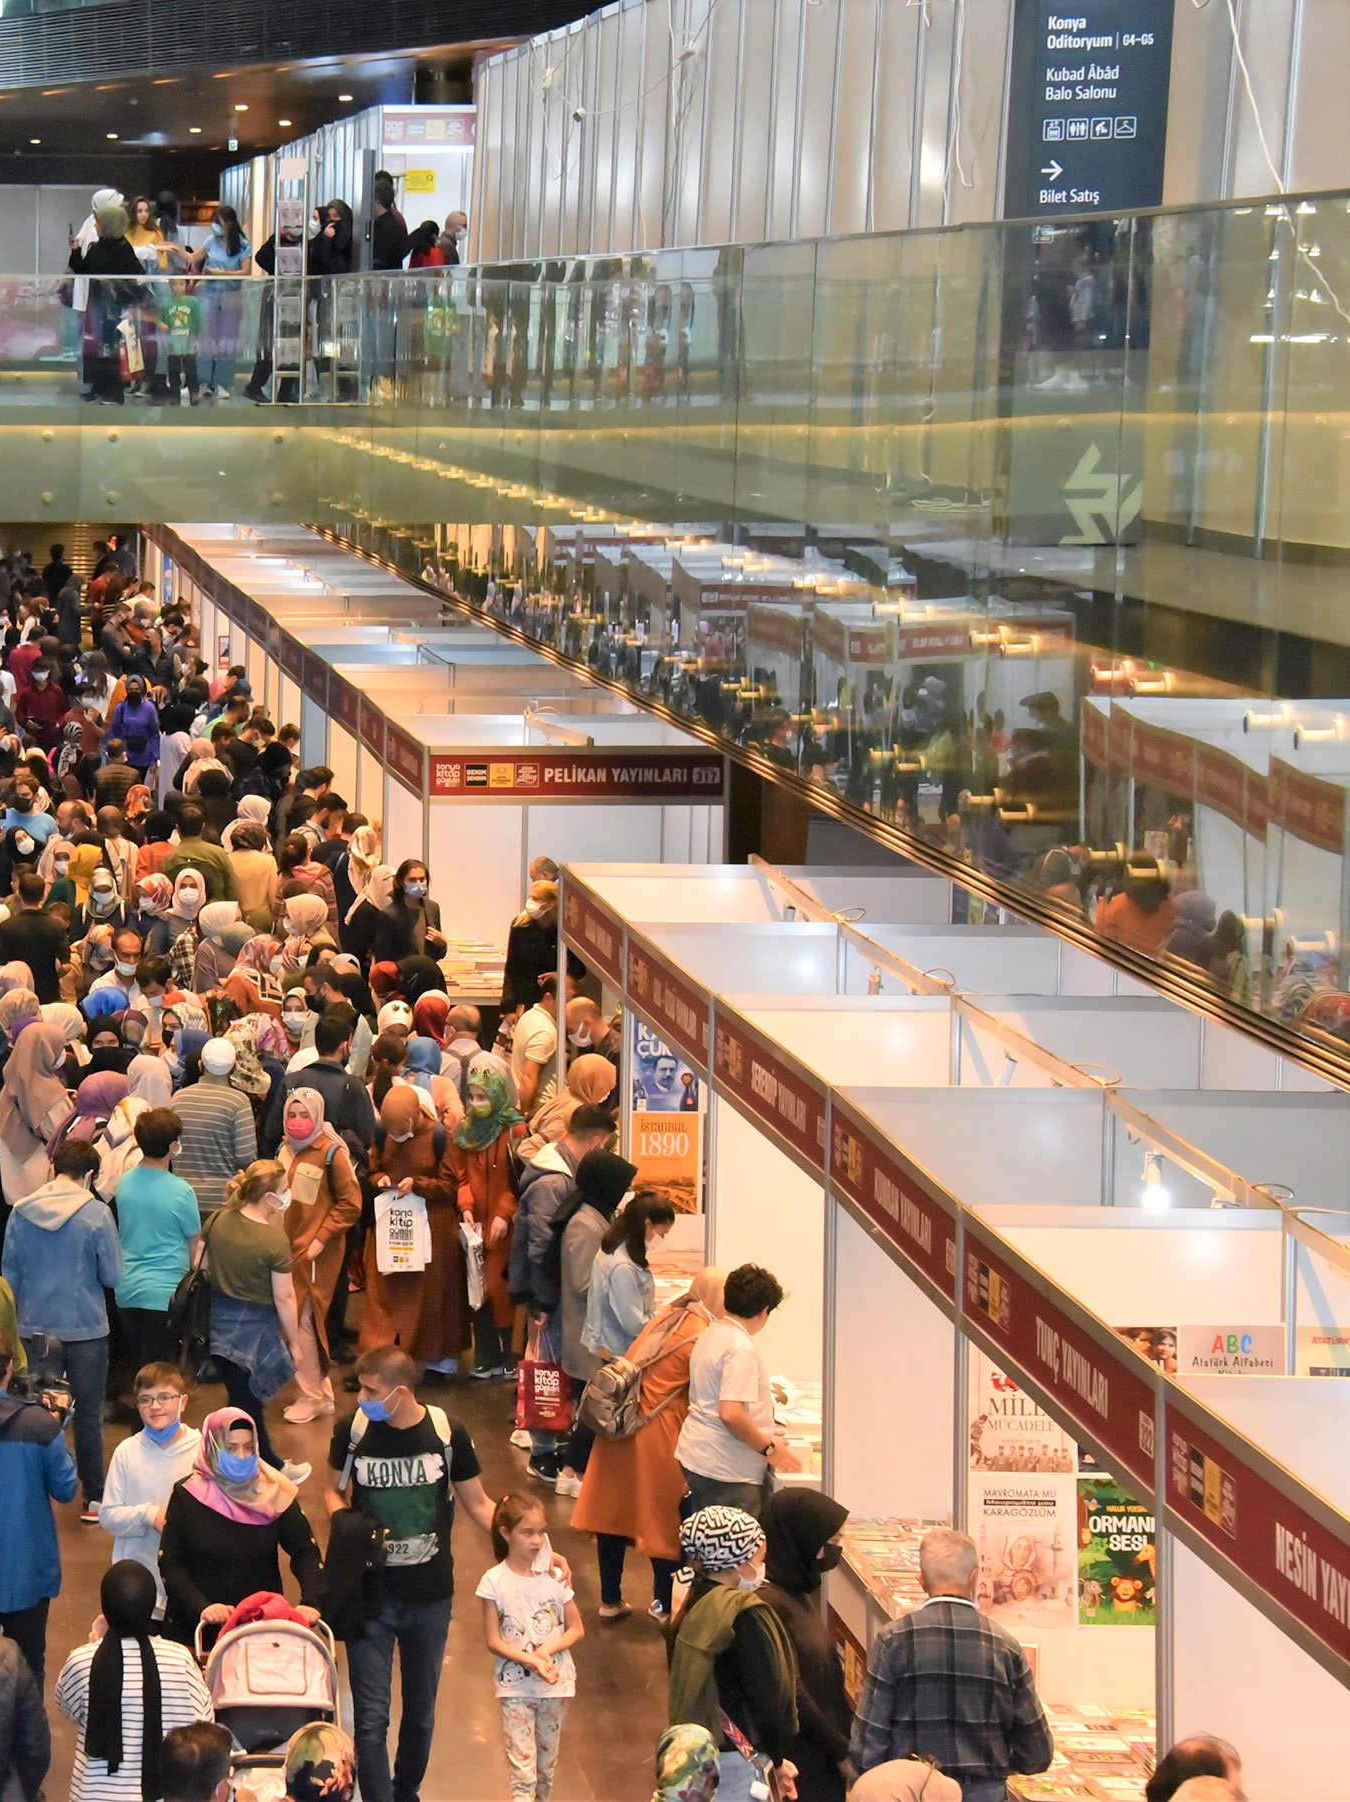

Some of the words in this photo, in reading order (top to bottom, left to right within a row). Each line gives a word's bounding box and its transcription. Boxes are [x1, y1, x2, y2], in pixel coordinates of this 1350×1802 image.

[1048, 16, 1087, 32] Konya
[1047, 34, 1113, 50] Oditoryum
[1122, 33, 1154, 47] G4-G5
[1046, 66, 1085, 82] Kubad
[1087, 64, 1120, 80] Âbâd
[1045, 86, 1073, 101] Balo
[1075, 85, 1117, 100] Salonu
[1039, 189, 1068, 204] Bilet
[1069, 189, 1100, 206] Satış
[436, 763, 461, 772] konya
[436, 770, 461, 779] kitap
[544, 764, 607, 783] PELİKAN
[611, 767, 688, 783] YAYINLARI
[639, 1133, 689, 1157] 1890
[1210, 1333, 1253, 1354] ABC
[1035, 1315, 1060, 1385] TUNÇ
[1061, 1338, 1109, 1420] YAYINLARI
[1191, 1356, 1229, 1368] Atatürk
[534, 1368, 560, 1379] konya
[534, 1375, 560, 1386] kitap
[988, 1393, 1046, 1416] MİLL
[987, 1417, 1056, 1432] MÜCADELE
[366, 1459, 428, 1486] KONYA
[983, 1489, 1039, 1498] MAVROMATA
[1041, 1489, 1056, 1498] MU
[983, 1507, 1056, 1517] KARAGÖZLÜM
[388, 1543, 409, 1555] 922
[1109, 1534, 1148, 1552] SESİ
[1275, 1520, 1317, 1602] NESİN
